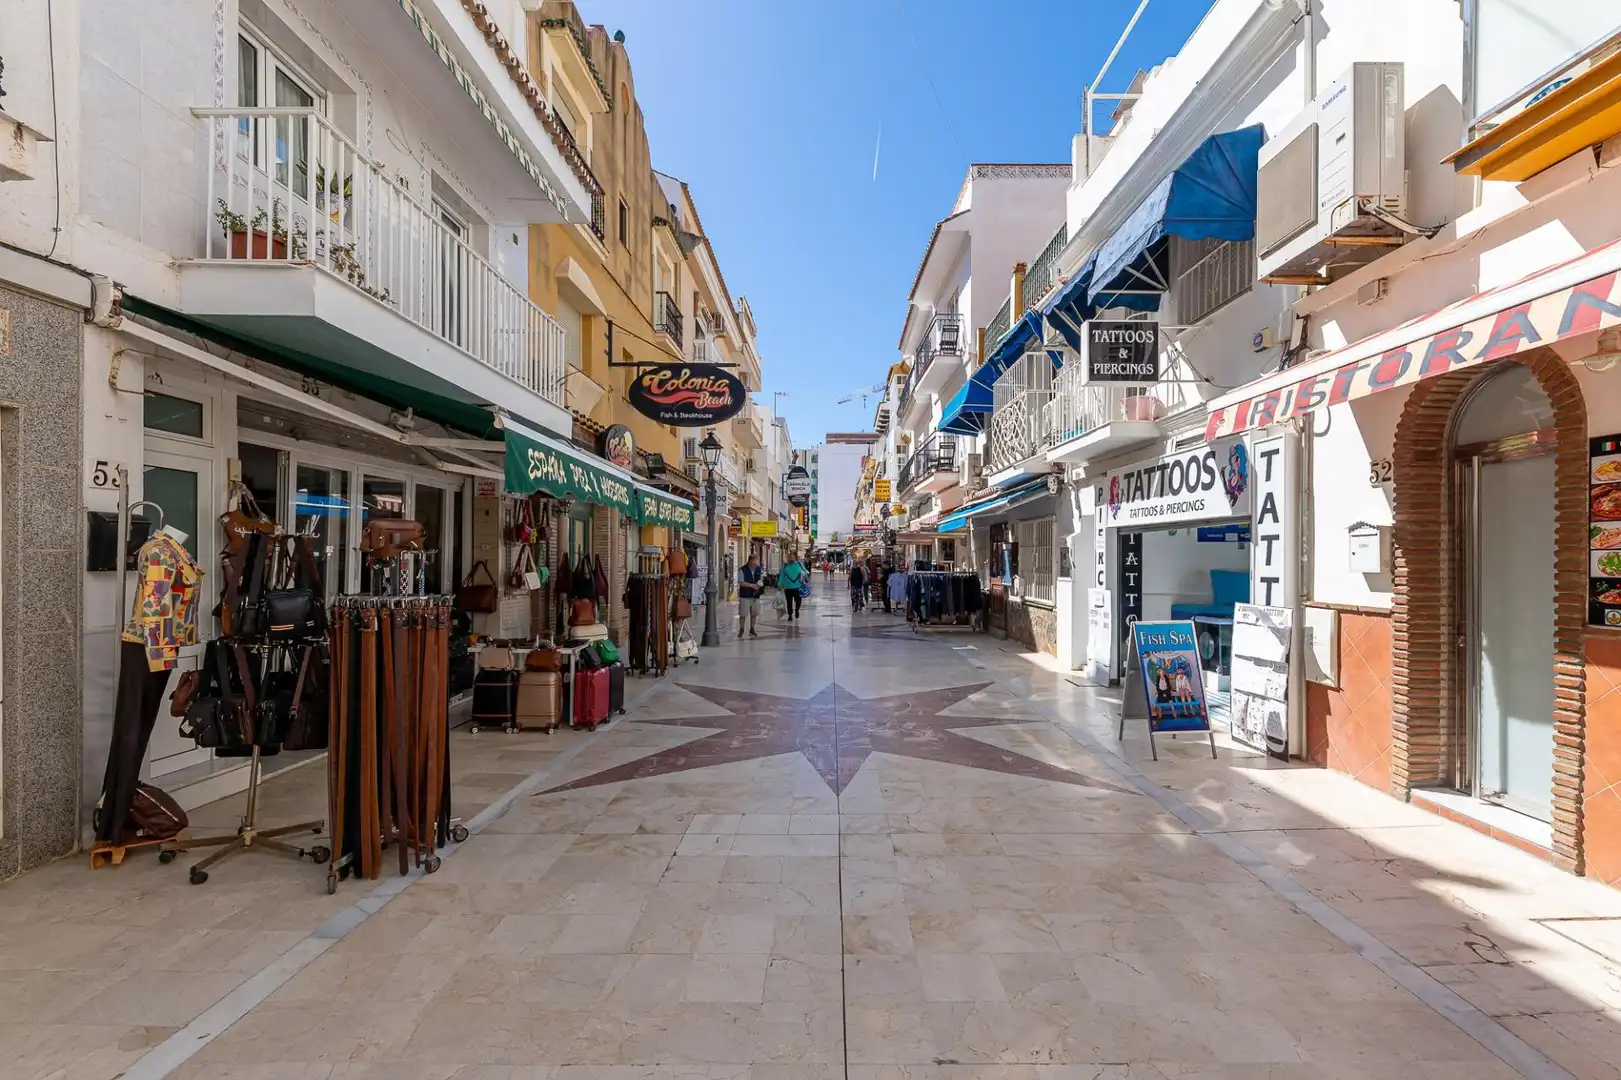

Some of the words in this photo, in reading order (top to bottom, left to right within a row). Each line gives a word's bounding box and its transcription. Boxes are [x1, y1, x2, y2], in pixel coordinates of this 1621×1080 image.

[1322, 85, 1346, 110] SAMSUNG
[1092, 330, 1155, 343] TATTOOS
[1118, 347, 1128, 359] &
[1093, 363, 1154, 375] PIERCINGS
[642, 368, 730, 396] Colonia
[695, 391, 733, 409] Beach
[680, 411, 713, 419] Steakhouse
[1123, 450, 1216, 503] TATTOOS
[1369, 460, 1392, 484] 52
[1129, 504, 1159, 518] TATTOOS
[1159, 505, 1165, 515] &
[1166, 499, 1205, 514] PIERCINGS
[1140, 631, 1166, 645] FISH
[1169, 630, 1193, 645] SPA
